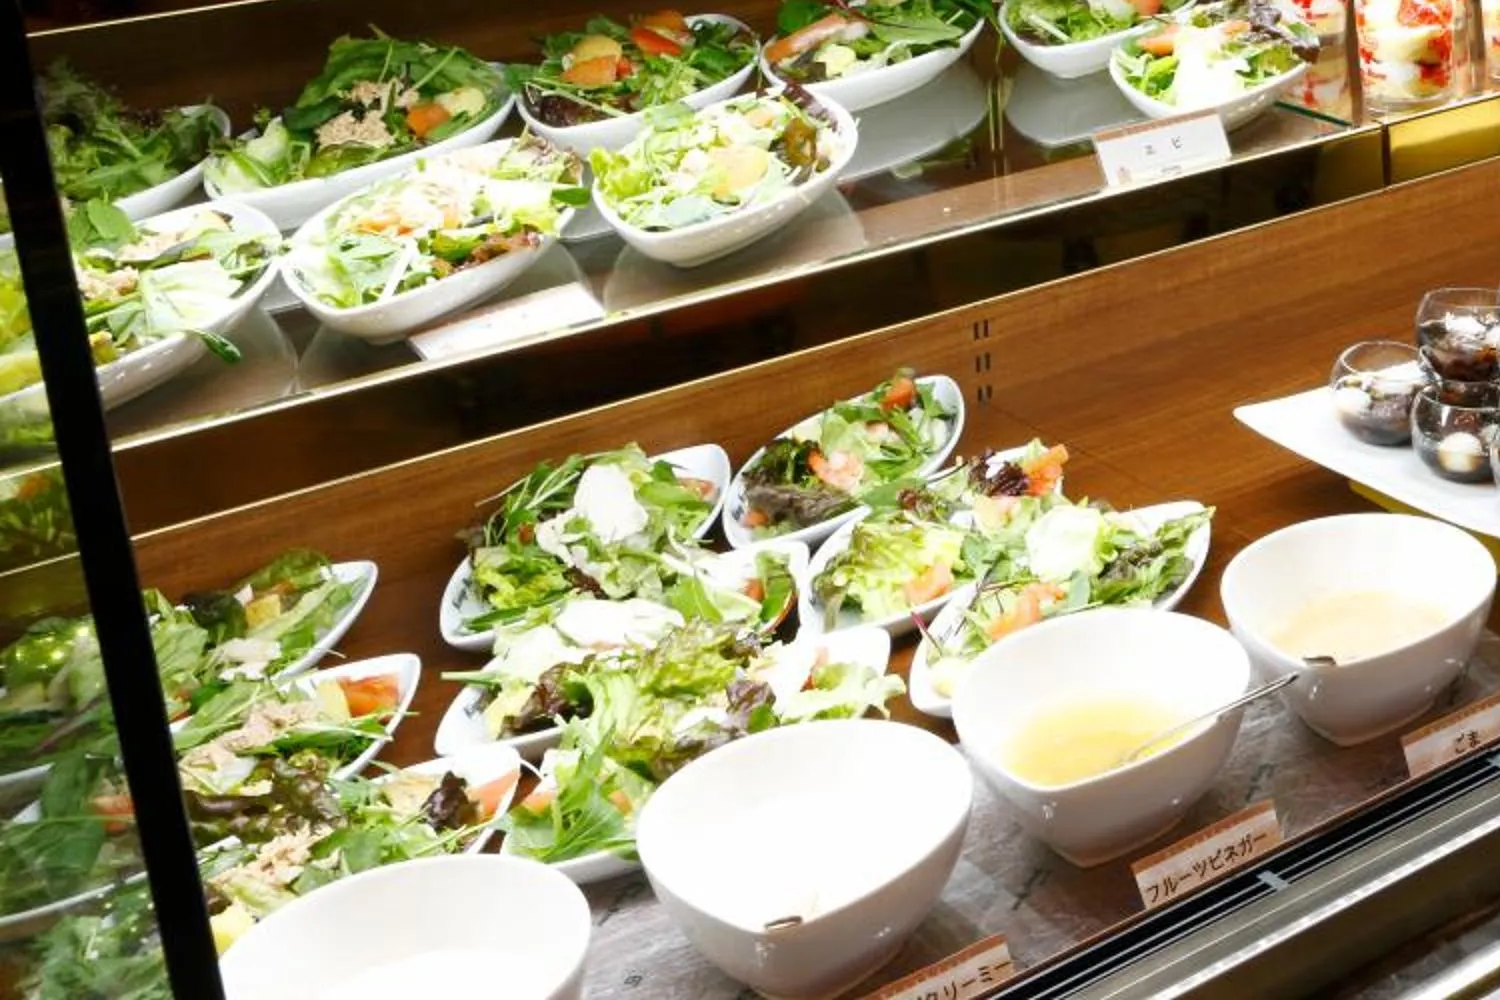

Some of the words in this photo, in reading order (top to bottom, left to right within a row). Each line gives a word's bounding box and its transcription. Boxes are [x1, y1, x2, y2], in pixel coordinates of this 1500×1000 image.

[1147, 834, 1266, 902] フルーツビネガー
